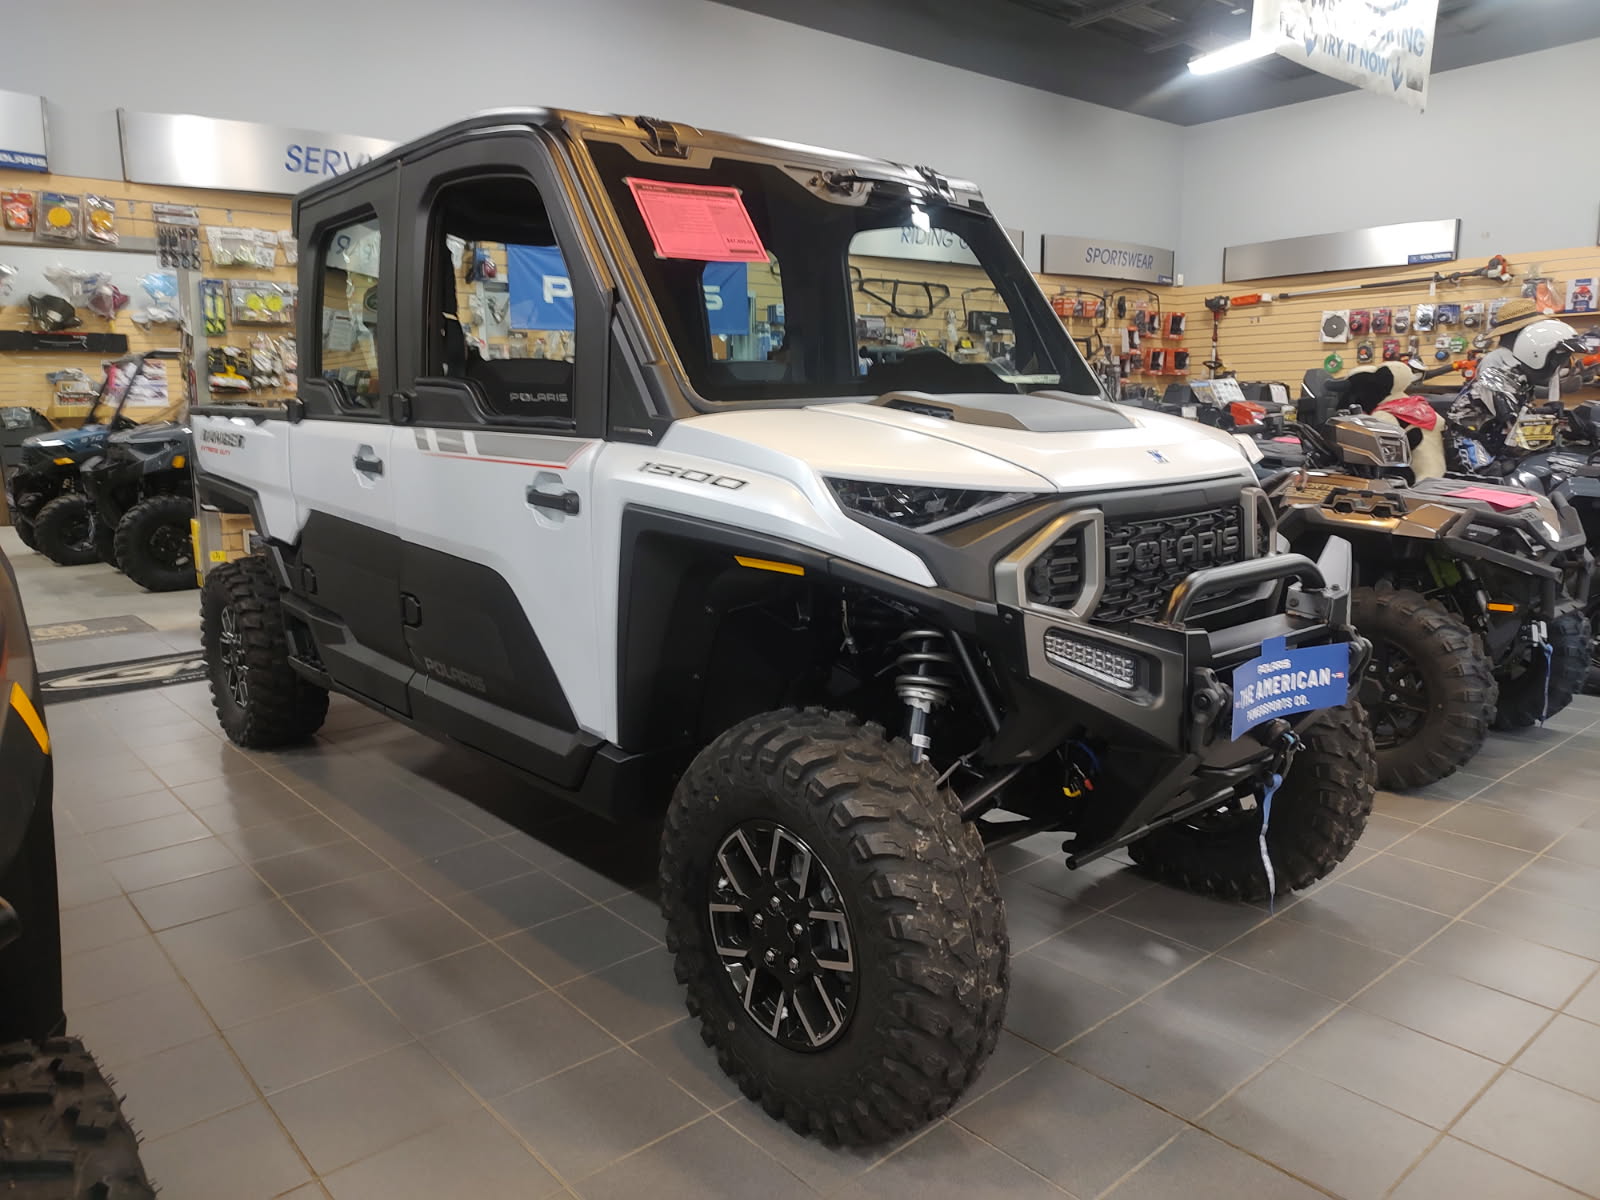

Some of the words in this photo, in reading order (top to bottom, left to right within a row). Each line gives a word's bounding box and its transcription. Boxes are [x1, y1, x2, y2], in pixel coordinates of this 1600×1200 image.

[1323, 33, 1343, 59] TRY
[1346, 42, 1357, 64] IT
[1359, 48, 1390, 76] NOW
[0, 152, 47, 168] OLARIS
[285, 144, 372, 176] SERV
[1085, 247, 1154, 270] SPORTSWEAR
[510, 392, 569, 402] POLARIS
[638, 461, 750, 491] 1500
[1109, 526, 1240, 576] POLARIS
[423, 656, 487, 693] POLARIS
[1239, 684, 1255, 709] THE
[1255, 667, 1331, 700] AMERICAN
